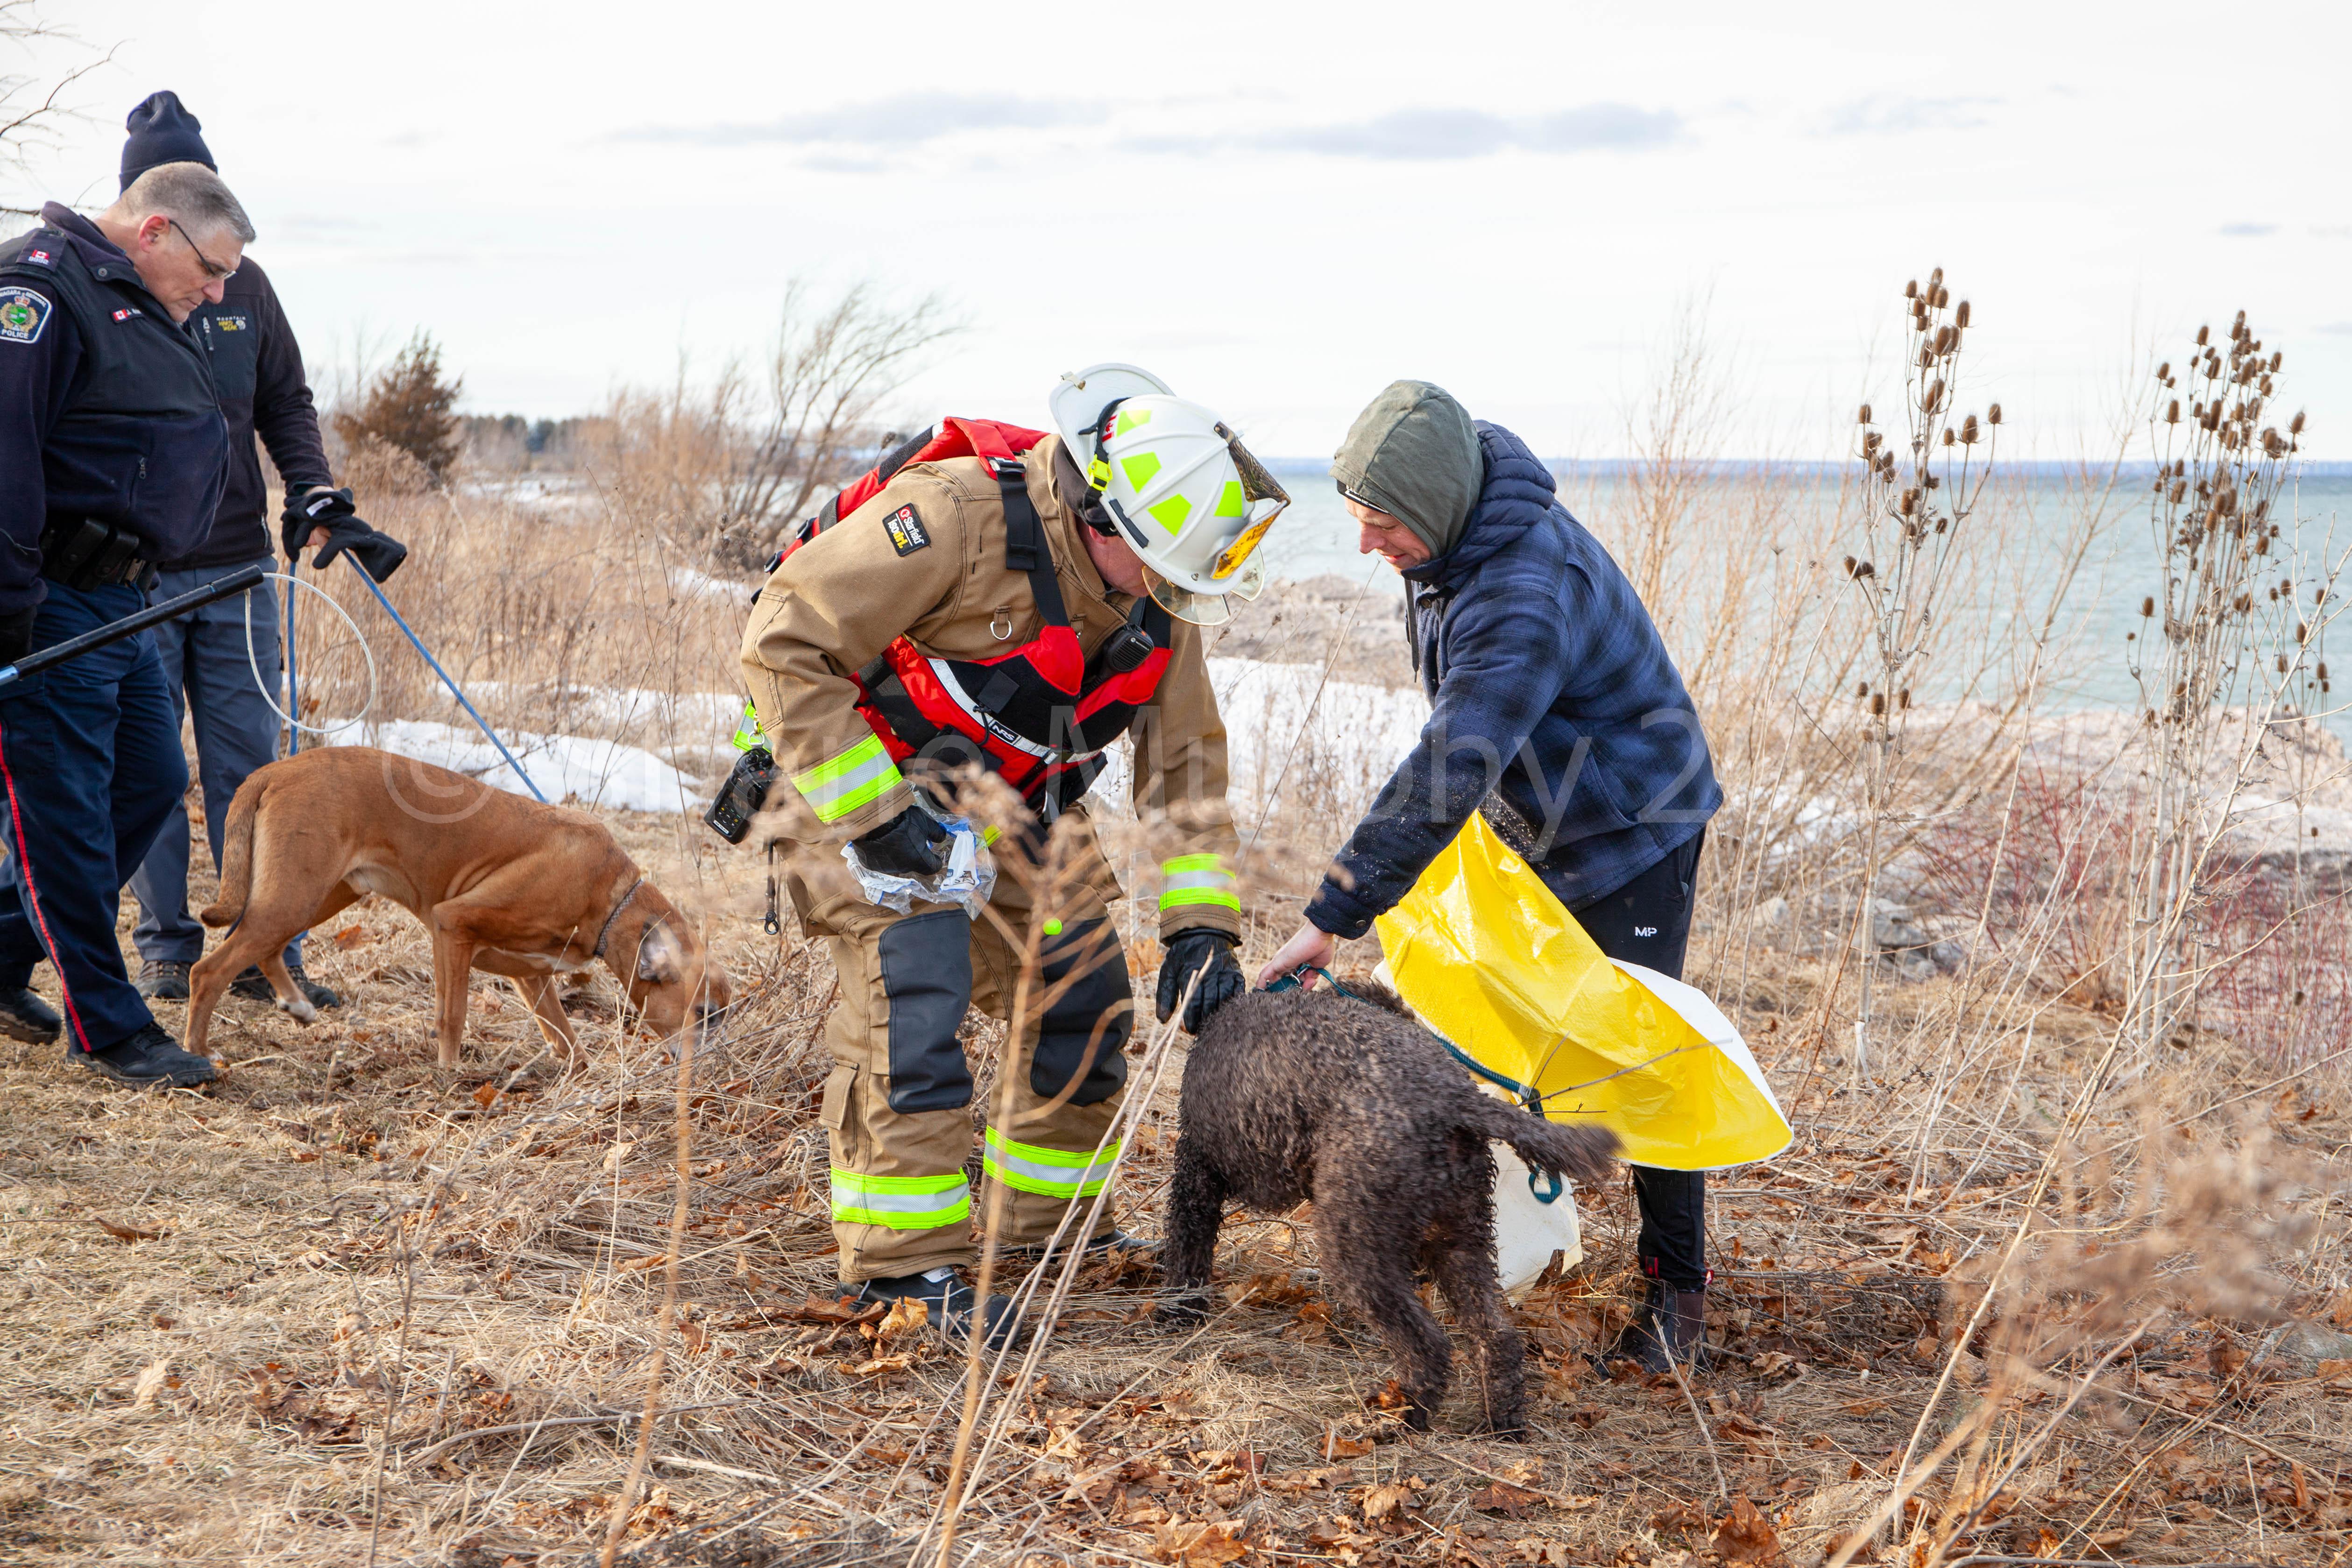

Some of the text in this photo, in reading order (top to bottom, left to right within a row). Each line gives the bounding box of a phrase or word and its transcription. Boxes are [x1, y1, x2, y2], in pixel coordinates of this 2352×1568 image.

[1, 328, 29, 340] POLICE
[992, 724, 1015, 741] NRS
[1635, 926, 1658, 937] MP
